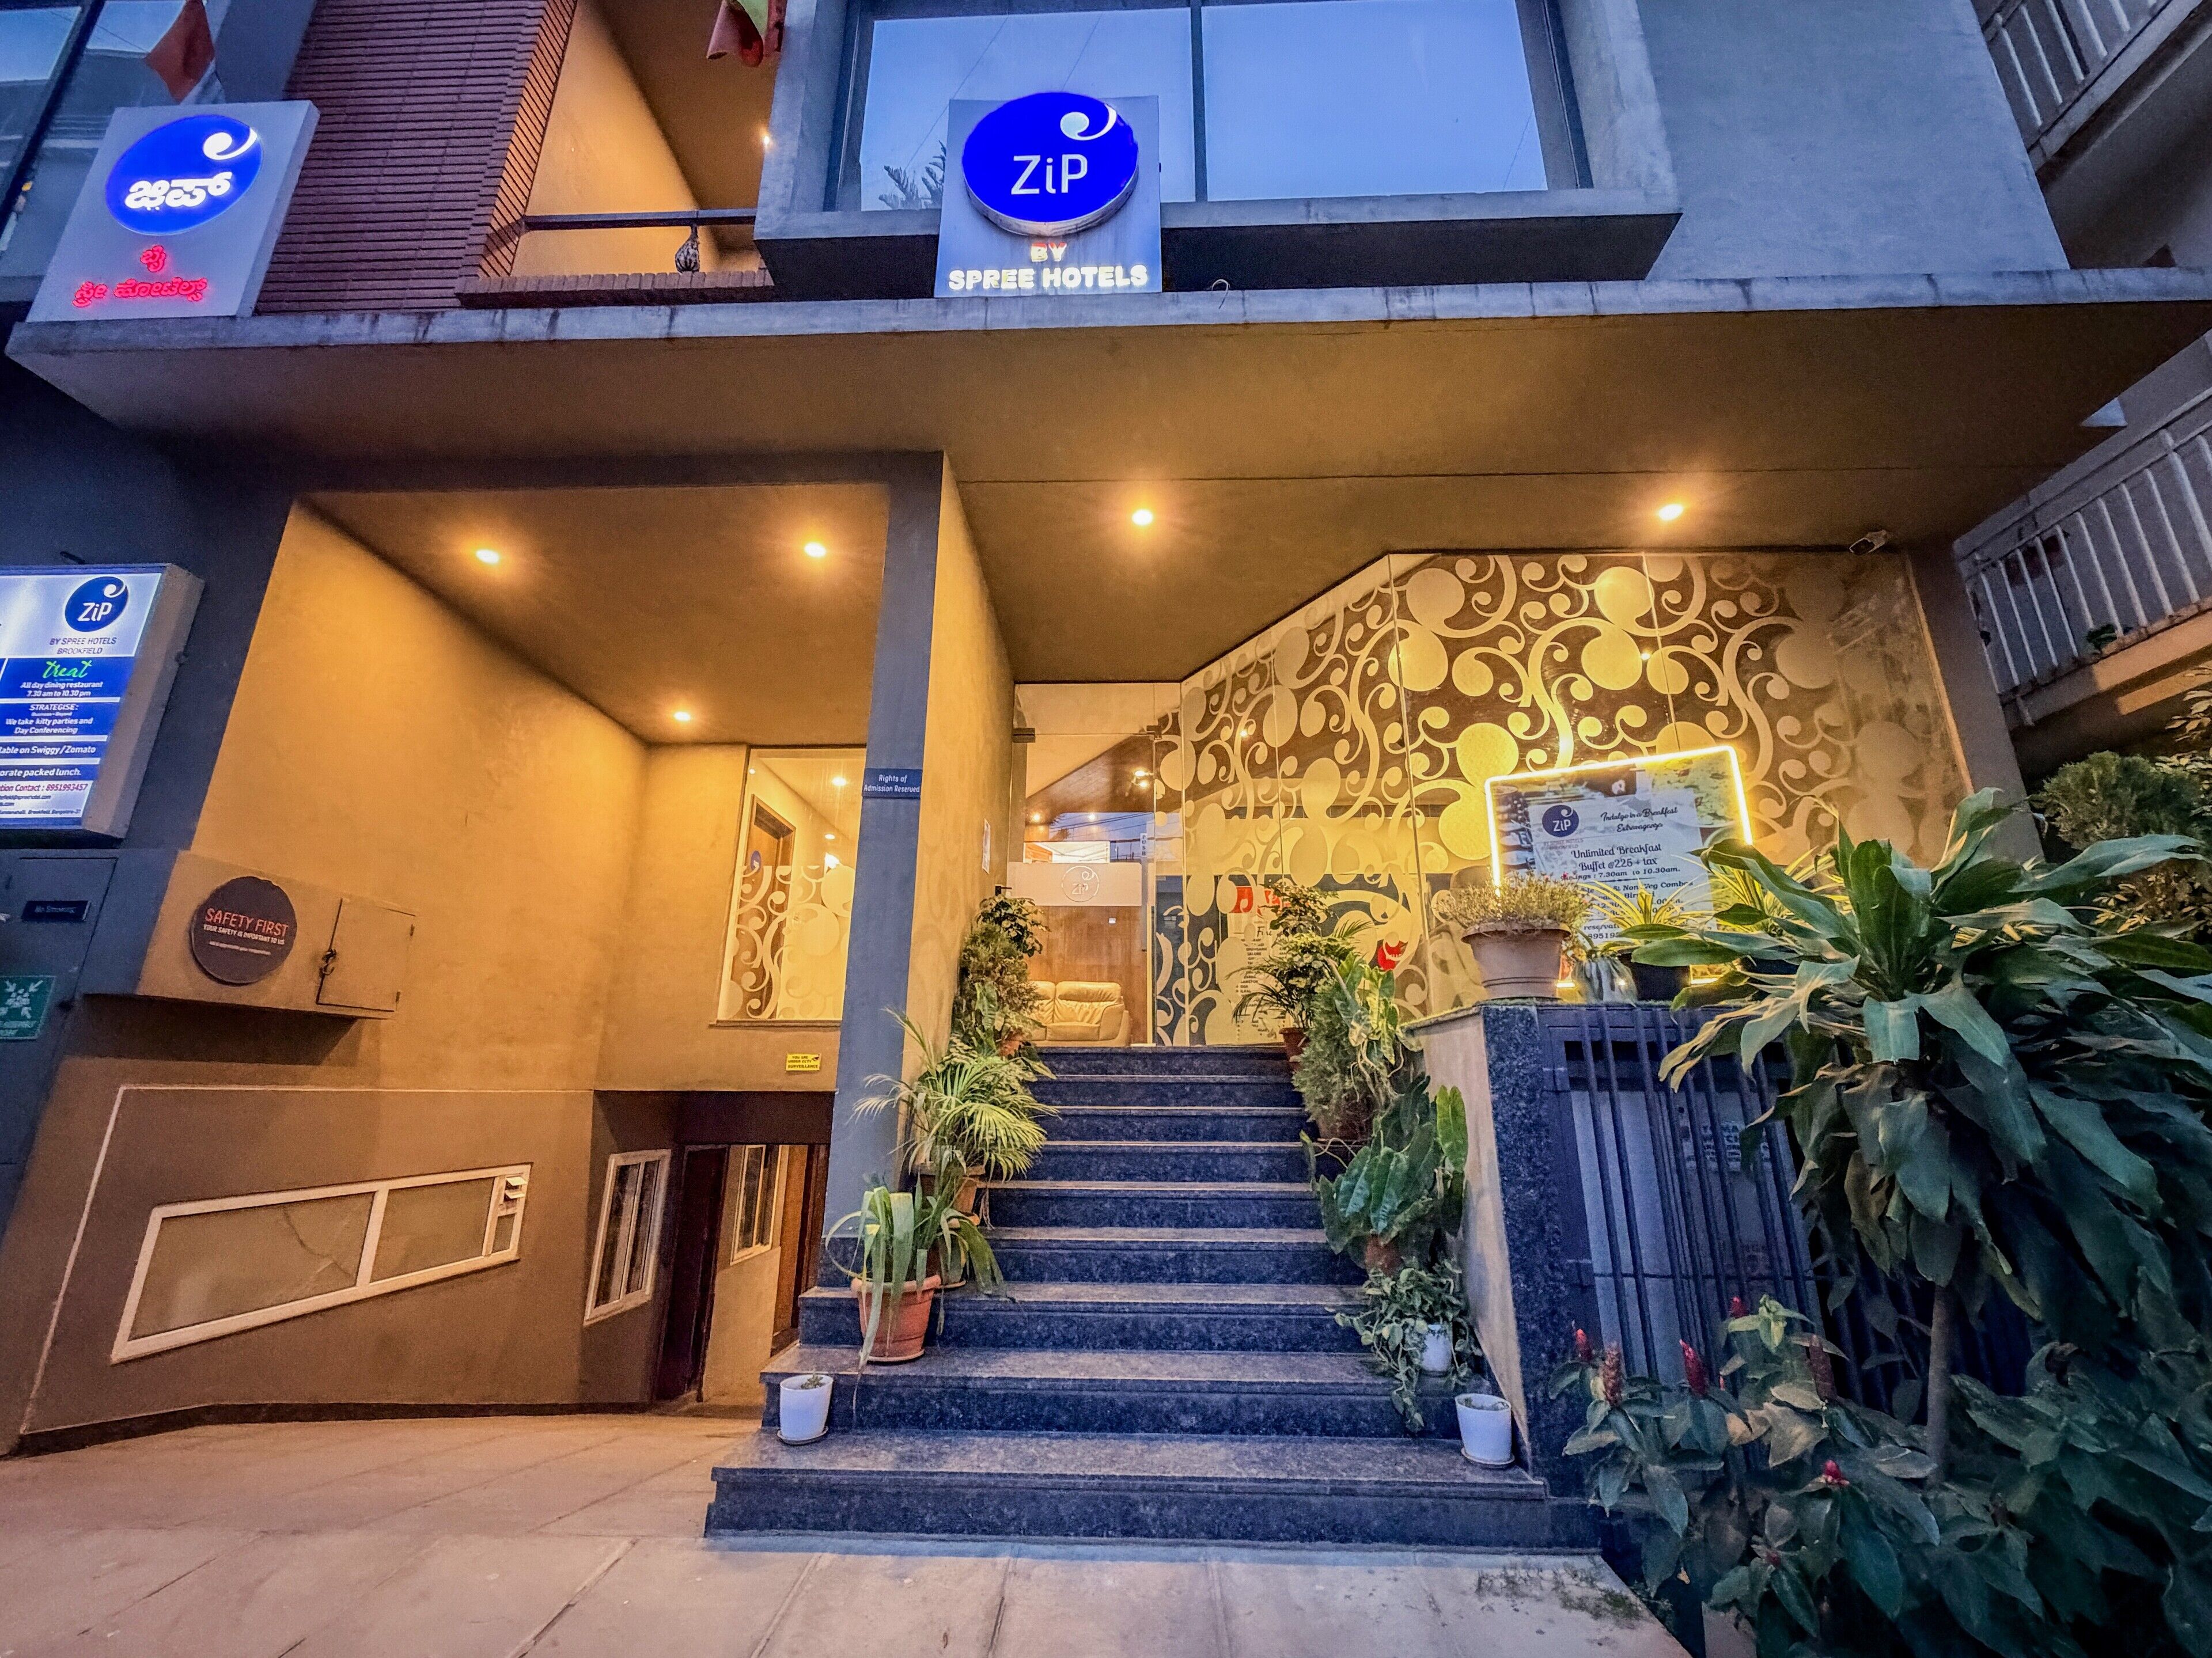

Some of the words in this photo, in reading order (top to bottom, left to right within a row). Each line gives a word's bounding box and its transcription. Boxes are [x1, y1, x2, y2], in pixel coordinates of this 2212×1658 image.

[1011, 153, 1088, 195] ZiP
[1030, 242, 1067, 263] BY
[948, 267, 1035, 291] SPREE
[1042, 264, 1148, 288] HOTELS
[77, 602, 112, 621] ZiP
[42, 660, 92, 678] treat
[35, 718, 52, 726] kitty
[29, 726, 78, 734] Conferencing
[23, 768, 56, 777] packed
[878, 774, 899, 783] Rights
[900, 775, 908, 783] of
[15, 784, 41, 792] Contact
[863, 784, 893, 792] Admission
[894, 784, 920, 793] Reserved
[1642, 807, 1678, 818] Breakfast
[1552, 819, 1571, 832] ZiP
[1571, 846, 1615, 859] Unlimited
[1616, 843, 1662, 855] Breakfast
[1578, 860, 1606, 872] Buffet
[1642, 857, 1659, 866] tax
[204, 908, 255, 931] SAFETY
[255, 918, 289, 937] FIRST
[203, 924, 218, 933] YOUR
[217, 927, 237, 936] SAFETY
[243, 932, 270, 943] IMPORTANT
